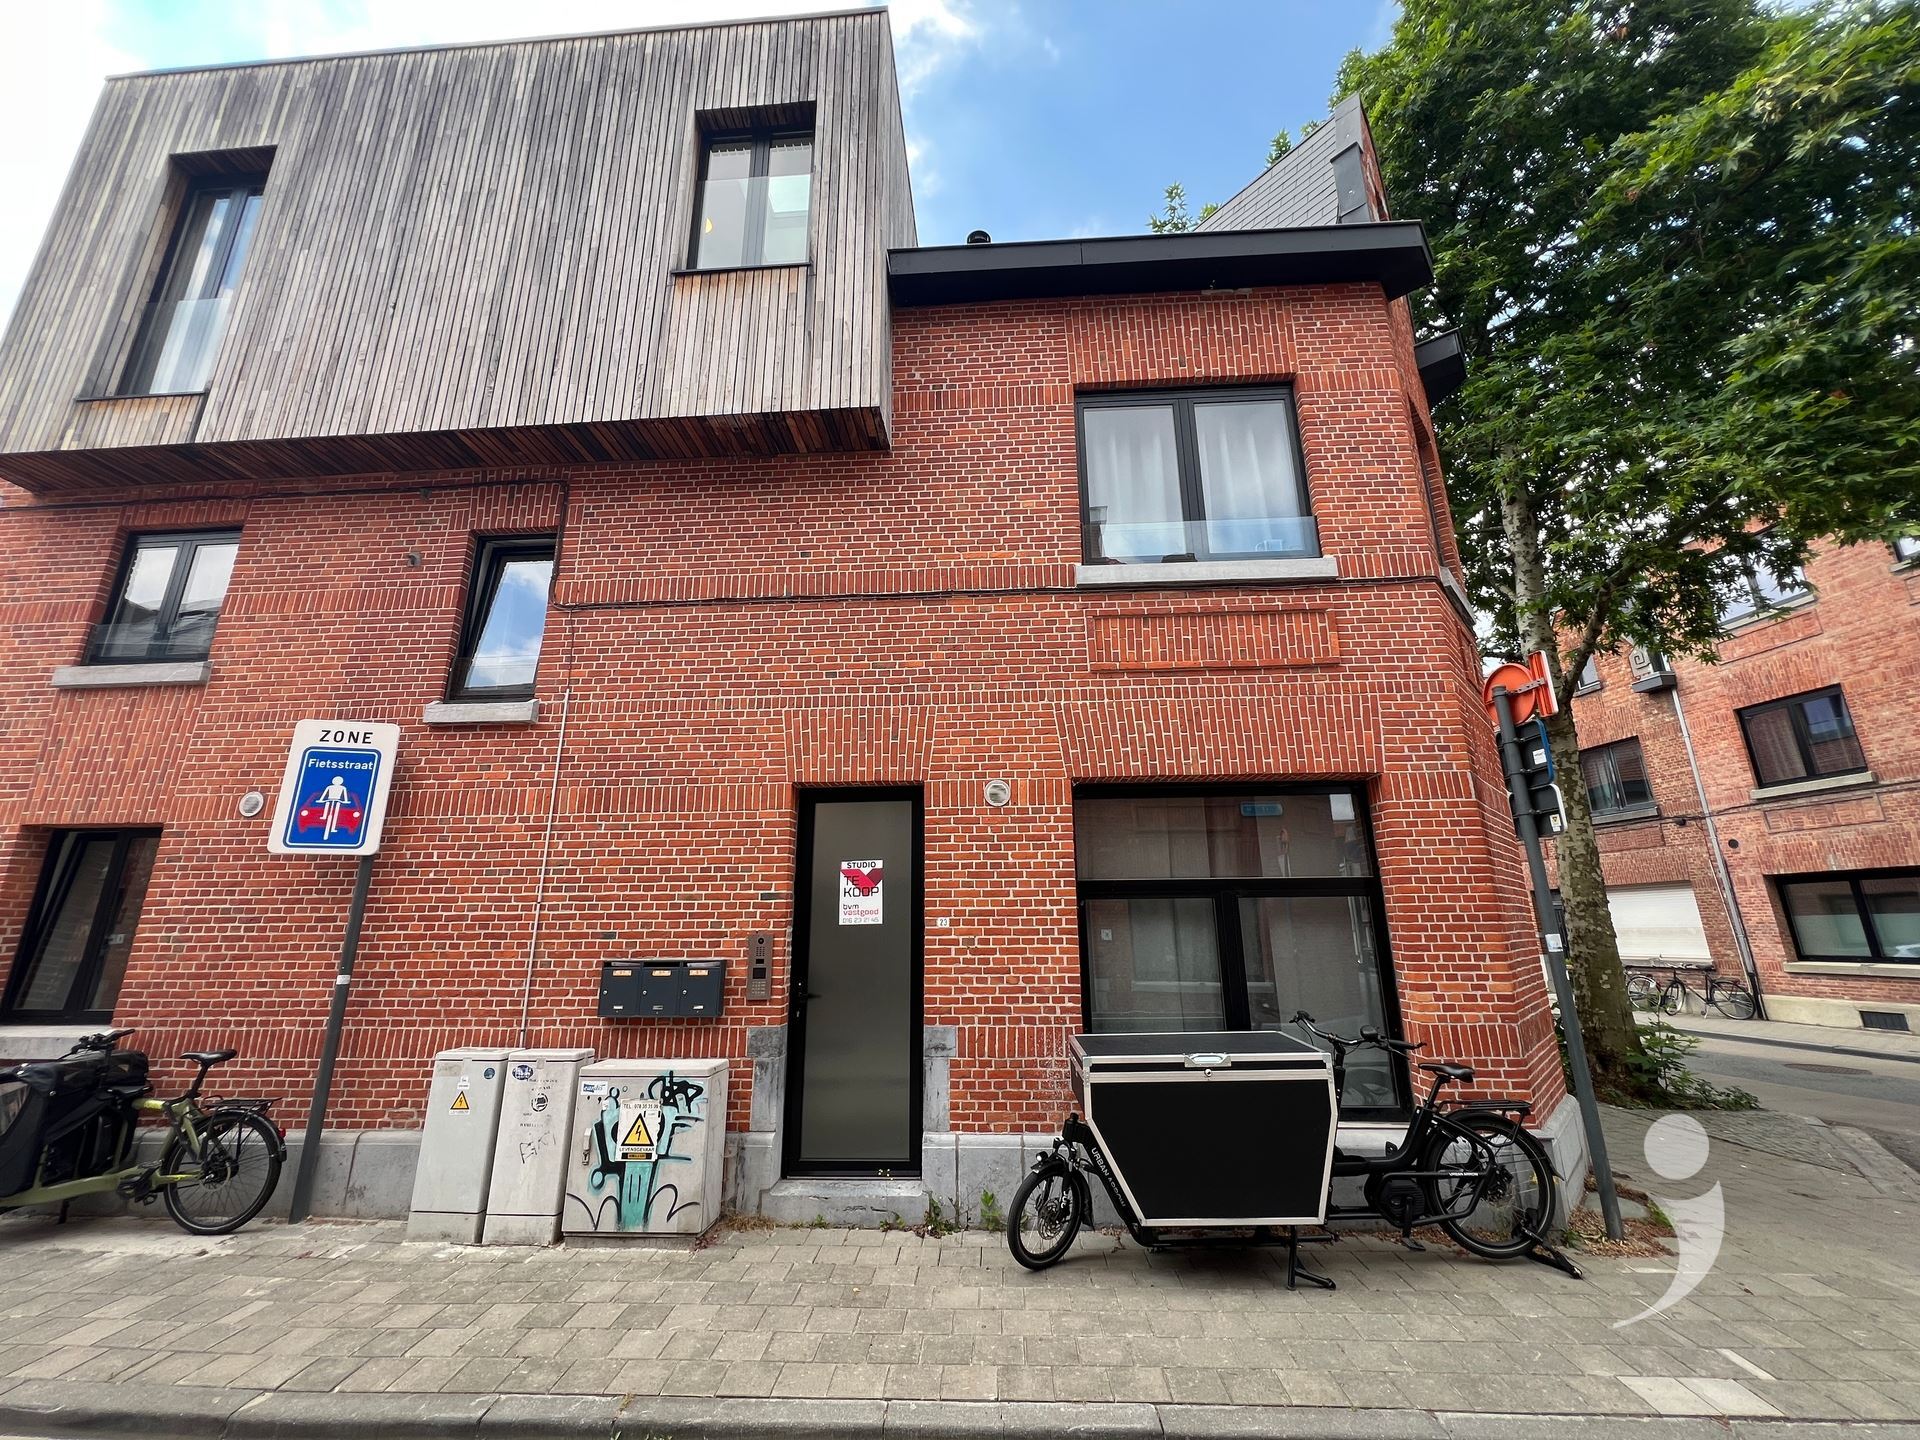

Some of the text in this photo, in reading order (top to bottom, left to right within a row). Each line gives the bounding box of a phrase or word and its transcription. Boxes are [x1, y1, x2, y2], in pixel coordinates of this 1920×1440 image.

[319, 729, 373, 744] ZONE
[308, 758, 374, 770] Fietsstraat
[846, 861, 877, 869] STUDIO
[843, 875, 860, 886] TE
[843, 886, 880, 897] KOOP
[939, 918, 948, 926] 23
[1091, 1147, 1110, 1176] URBAN
